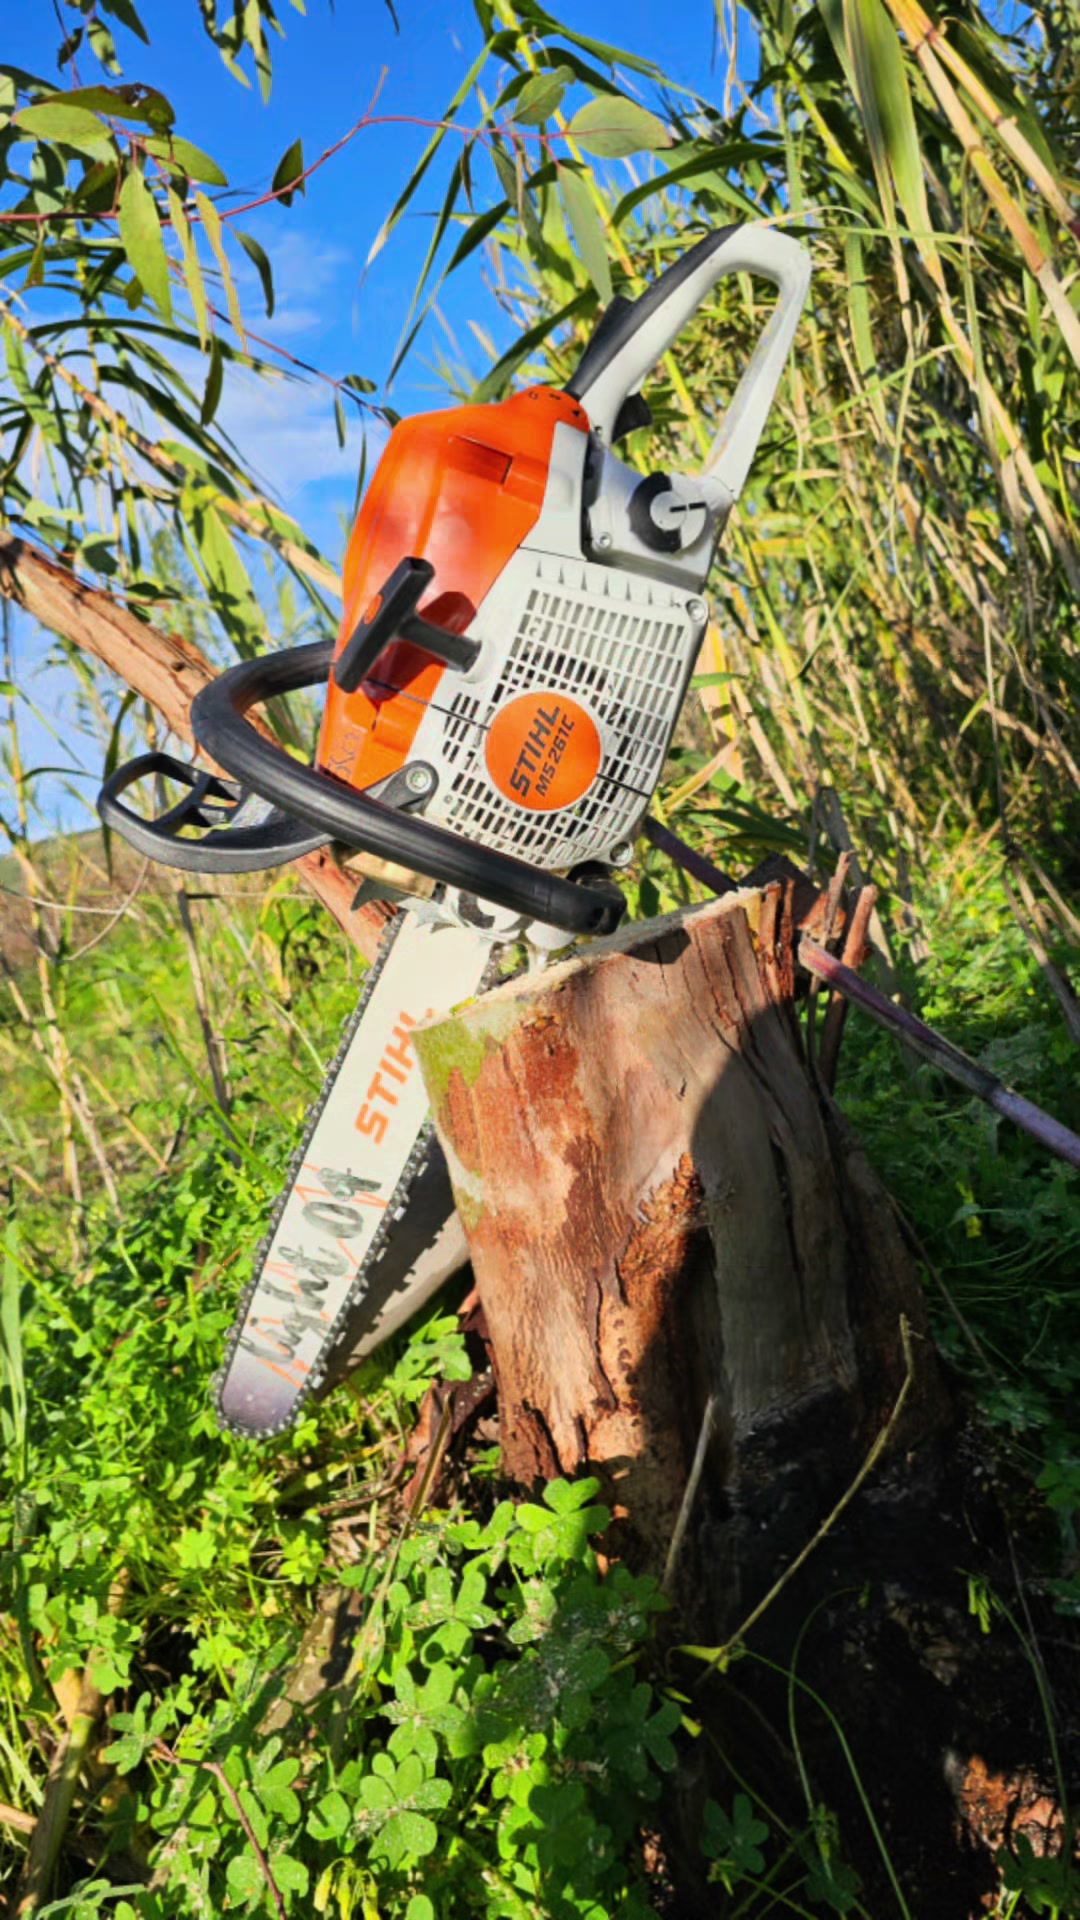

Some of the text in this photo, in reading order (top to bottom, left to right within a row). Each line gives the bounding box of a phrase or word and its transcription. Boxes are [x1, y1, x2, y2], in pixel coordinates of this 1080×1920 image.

[509, 706, 561, 798] STIHL
[534, 714, 575, 797] MS 261C
[302, 1167, 383, 1239] 04
